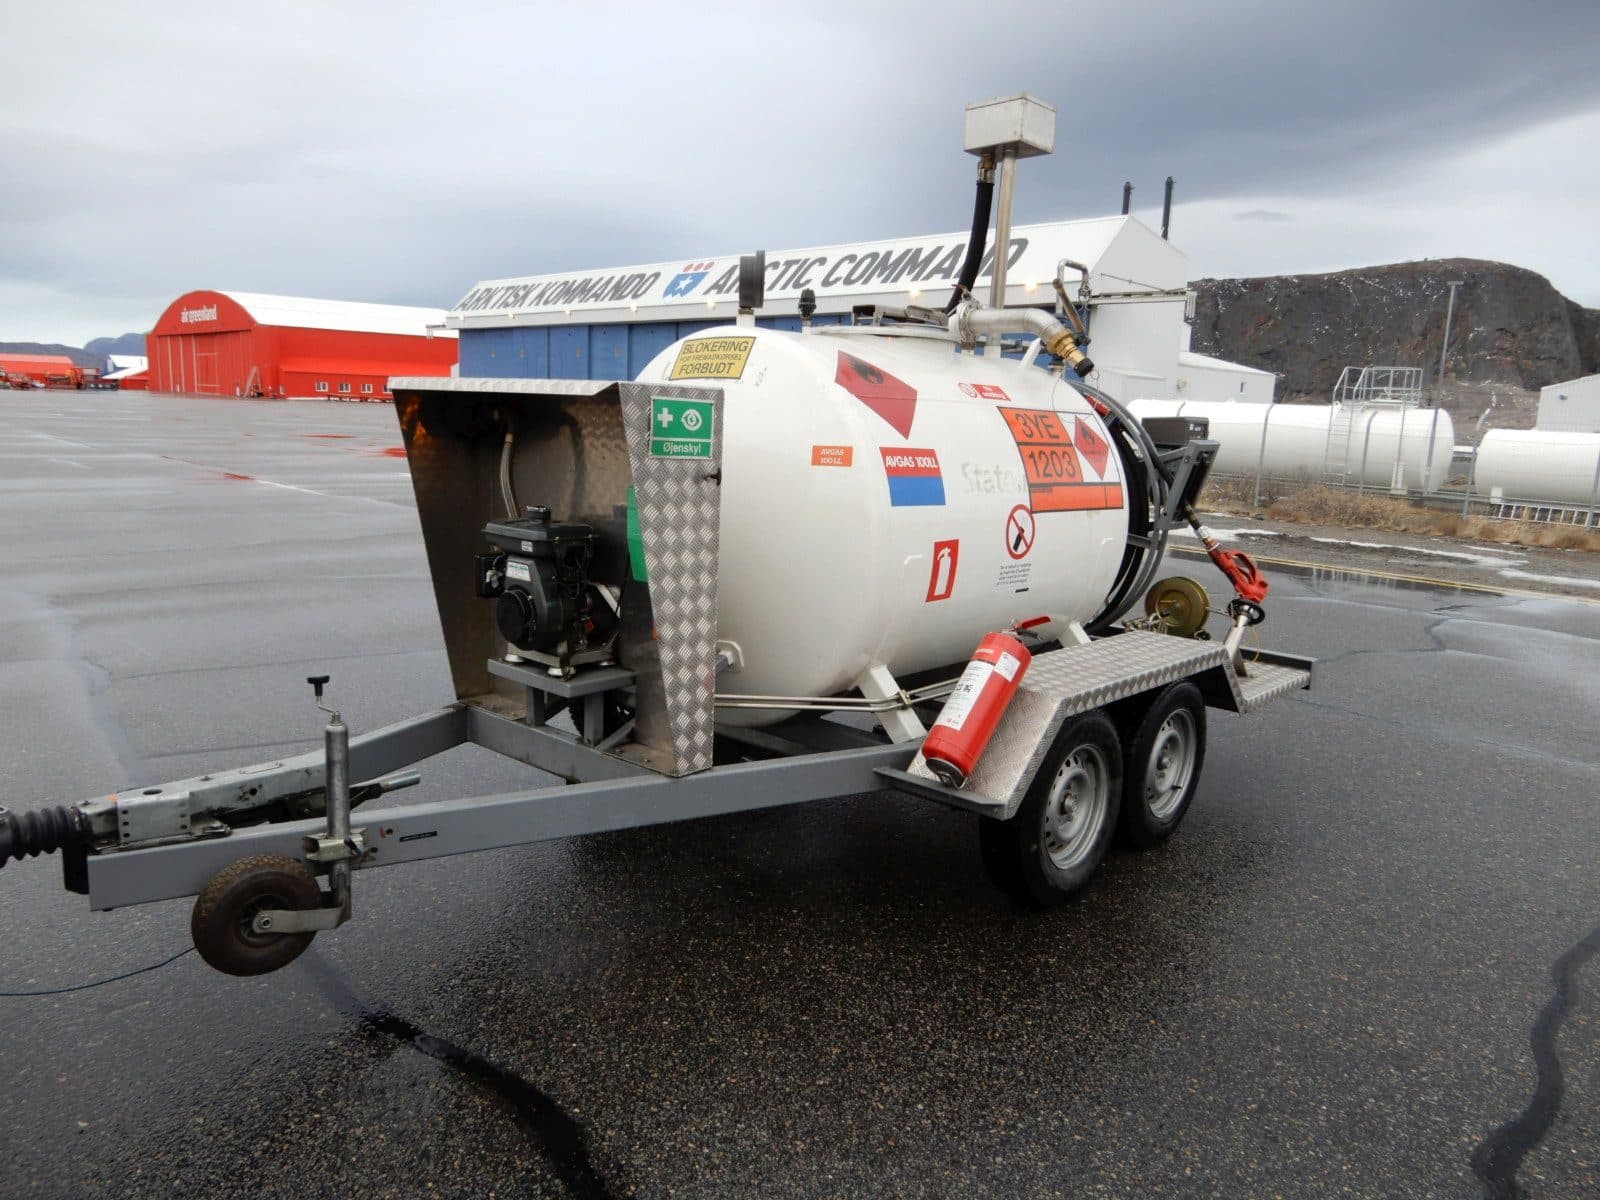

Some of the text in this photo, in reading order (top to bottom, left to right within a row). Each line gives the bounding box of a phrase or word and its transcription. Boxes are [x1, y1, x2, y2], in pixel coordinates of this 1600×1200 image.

[453, 283, 540, 312] ARKTISK
[528, 271, 662, 308] KOMMANDO
[682, 340, 749, 355] BLOKERING
[679, 362, 735, 376] FORBUDT
[1015, 413, 1060, 439] 3YE
[663, 442, 701, 455] Øjenskyl
[820, 448, 845, 456] AVGAS
[885, 455, 939, 469] AVGAS 100LL
[1029, 450, 1076, 478] 1203
